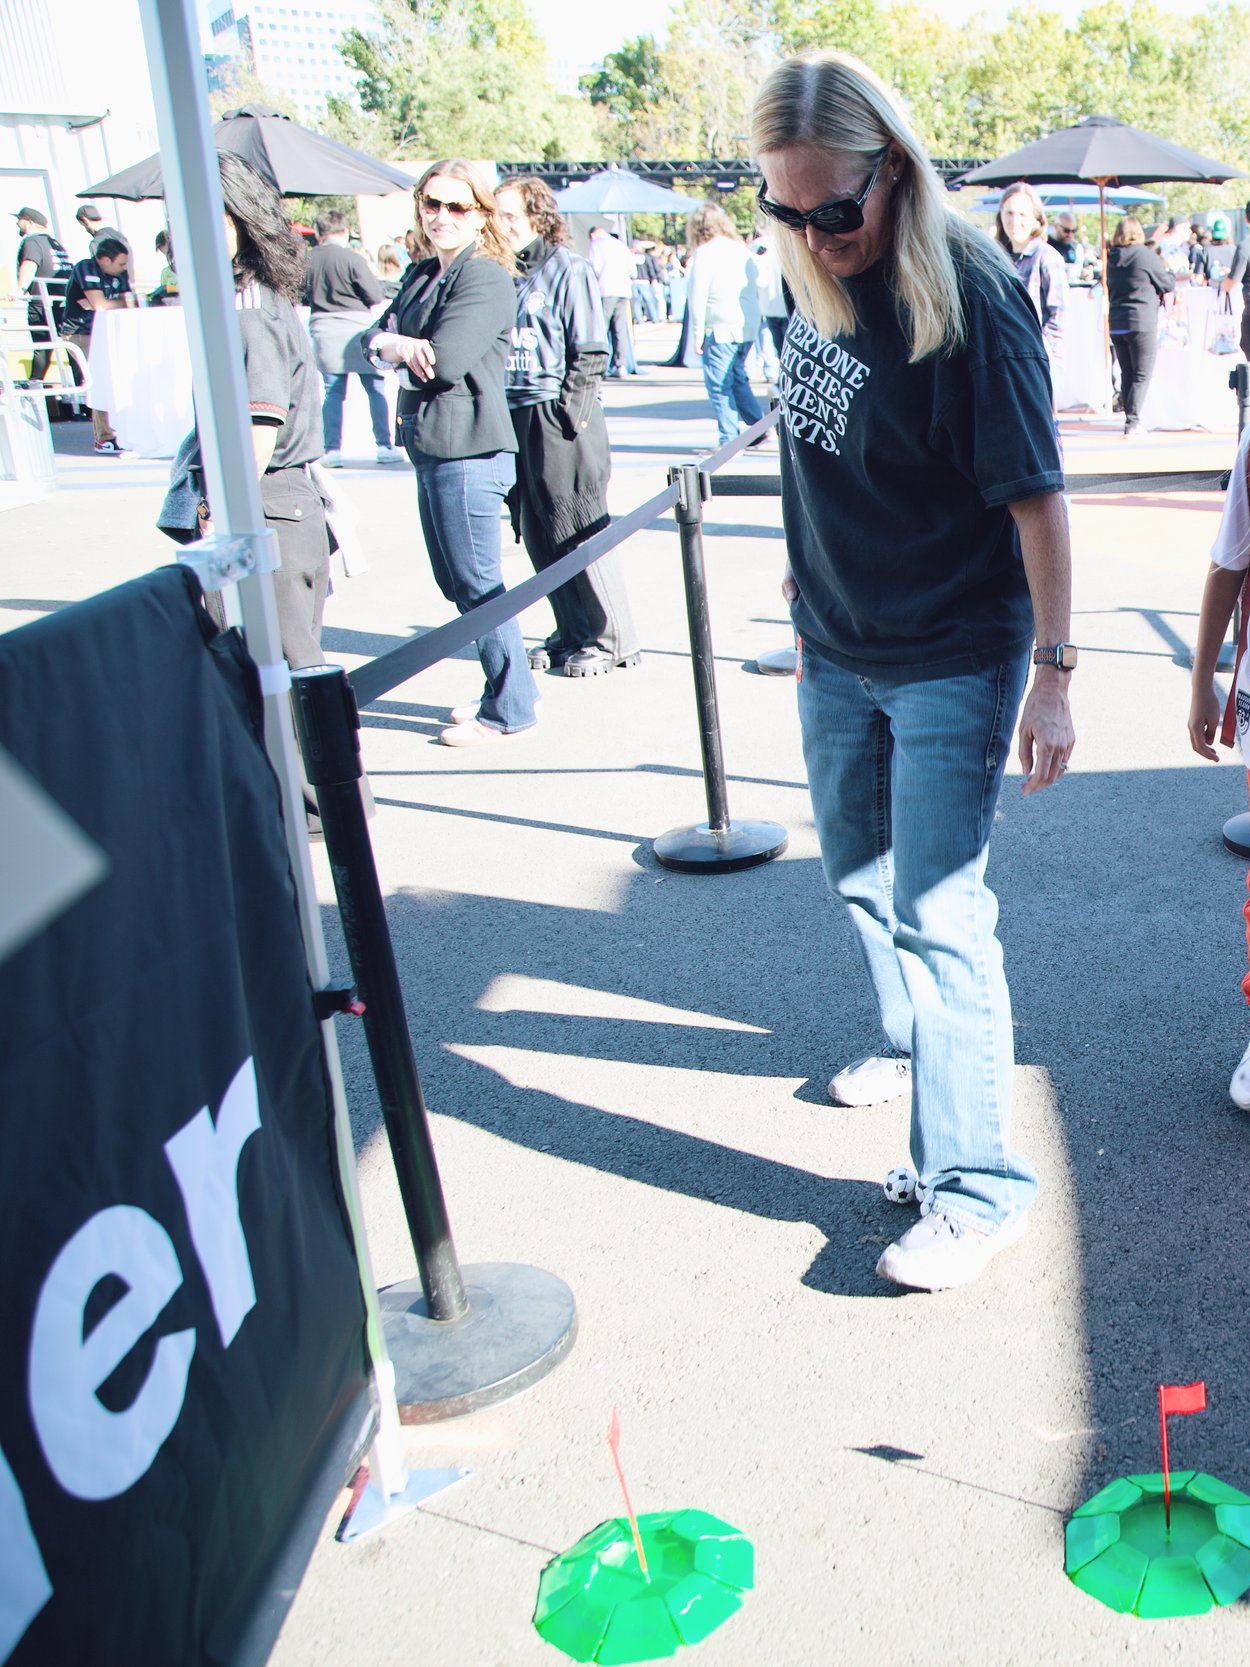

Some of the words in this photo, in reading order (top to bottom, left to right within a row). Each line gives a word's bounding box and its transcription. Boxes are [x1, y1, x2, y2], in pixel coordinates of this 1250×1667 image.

[511, 327, 539, 351] VS
[784, 309, 871, 390] VERYONE
[778, 368, 848, 437] OMEN'S
[778, 394, 841, 456] SORTS.
[0, 1055, 262, 1667] er
